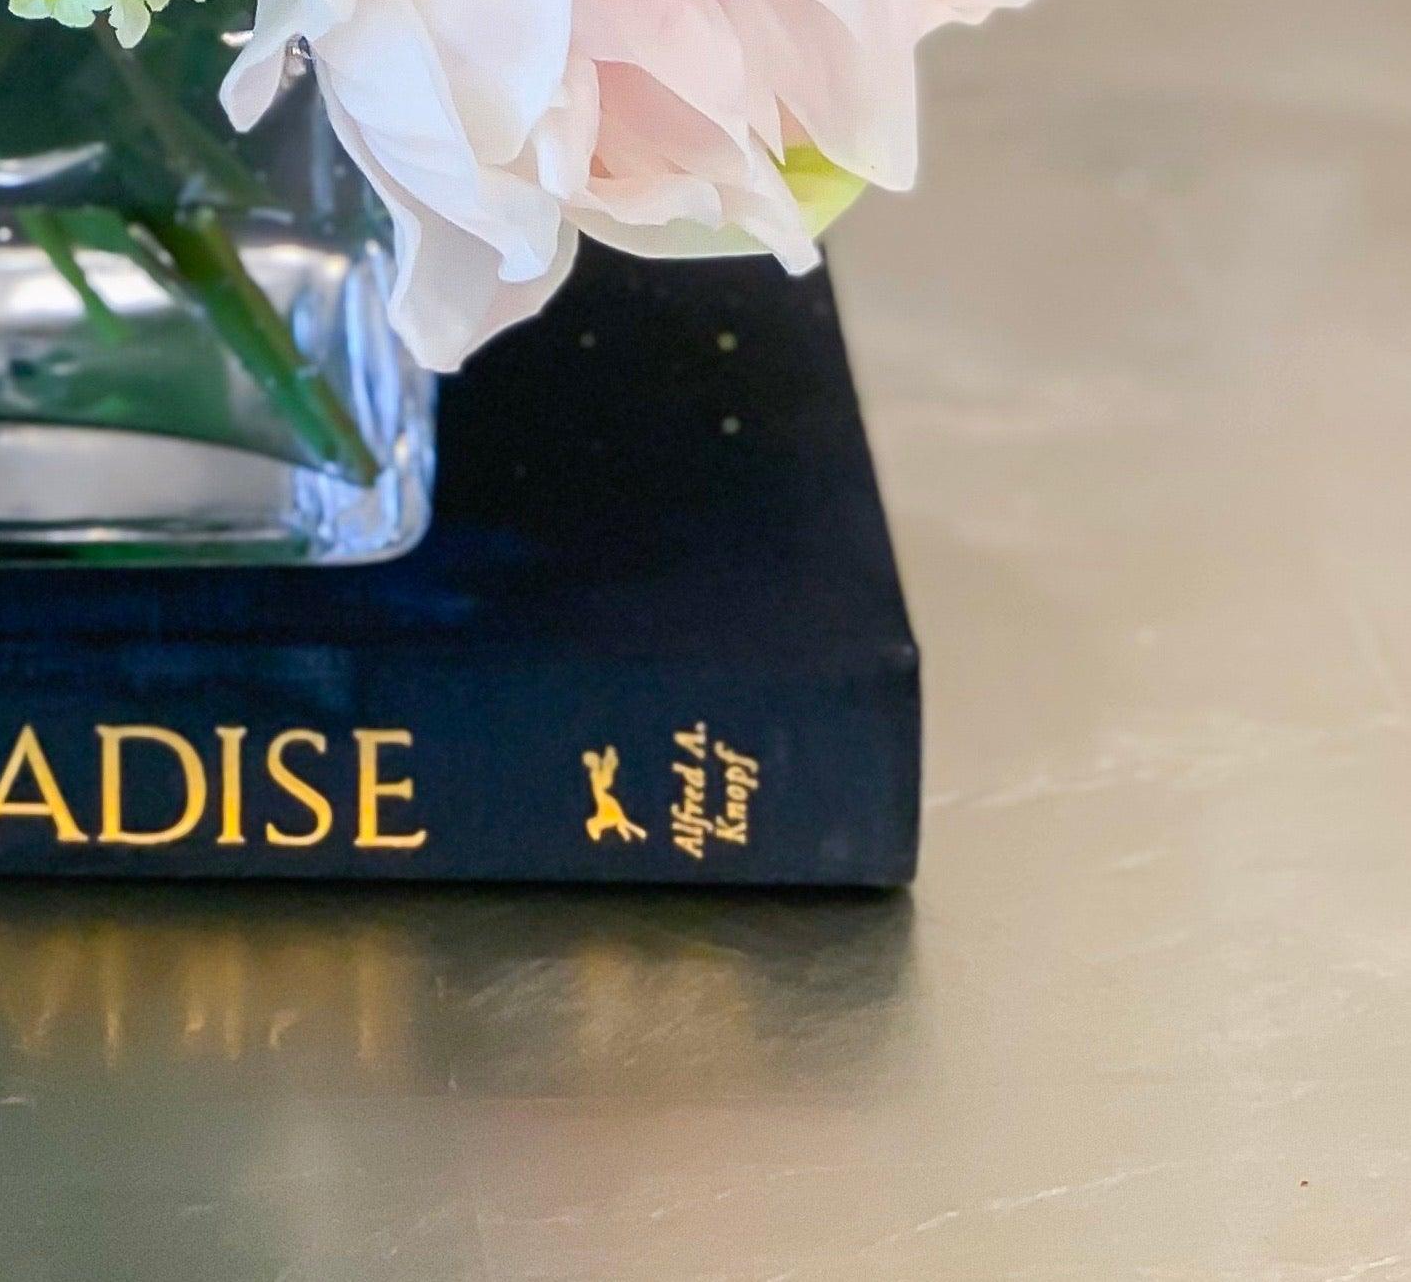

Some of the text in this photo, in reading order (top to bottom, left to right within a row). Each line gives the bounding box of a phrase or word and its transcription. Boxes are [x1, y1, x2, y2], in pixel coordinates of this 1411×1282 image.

[670, 720, 714, 860] Alfred A.
[713, 740, 760, 845] Knopf
